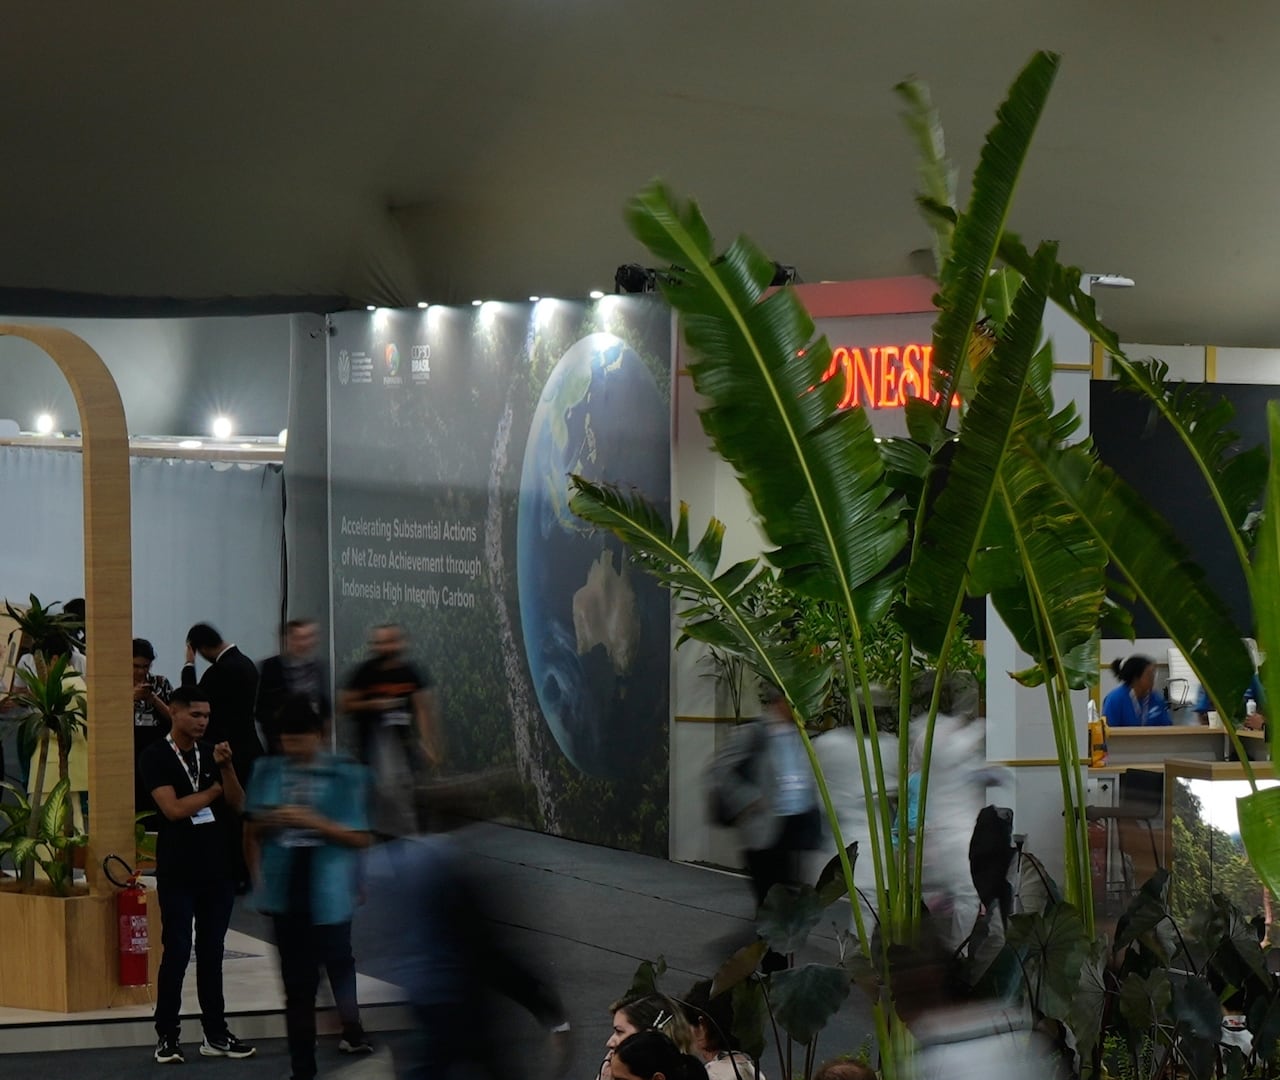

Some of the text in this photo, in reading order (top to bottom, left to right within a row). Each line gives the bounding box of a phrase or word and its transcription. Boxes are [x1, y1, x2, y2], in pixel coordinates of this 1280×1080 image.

[799, 344, 961, 409] ONESI
[341, 516, 477, 542] Accelerating Substantial Actions
[341, 547, 482, 580] of Net Zero Achievement through
[342, 577, 475, 609] Indonesia High Integrity Carbon
